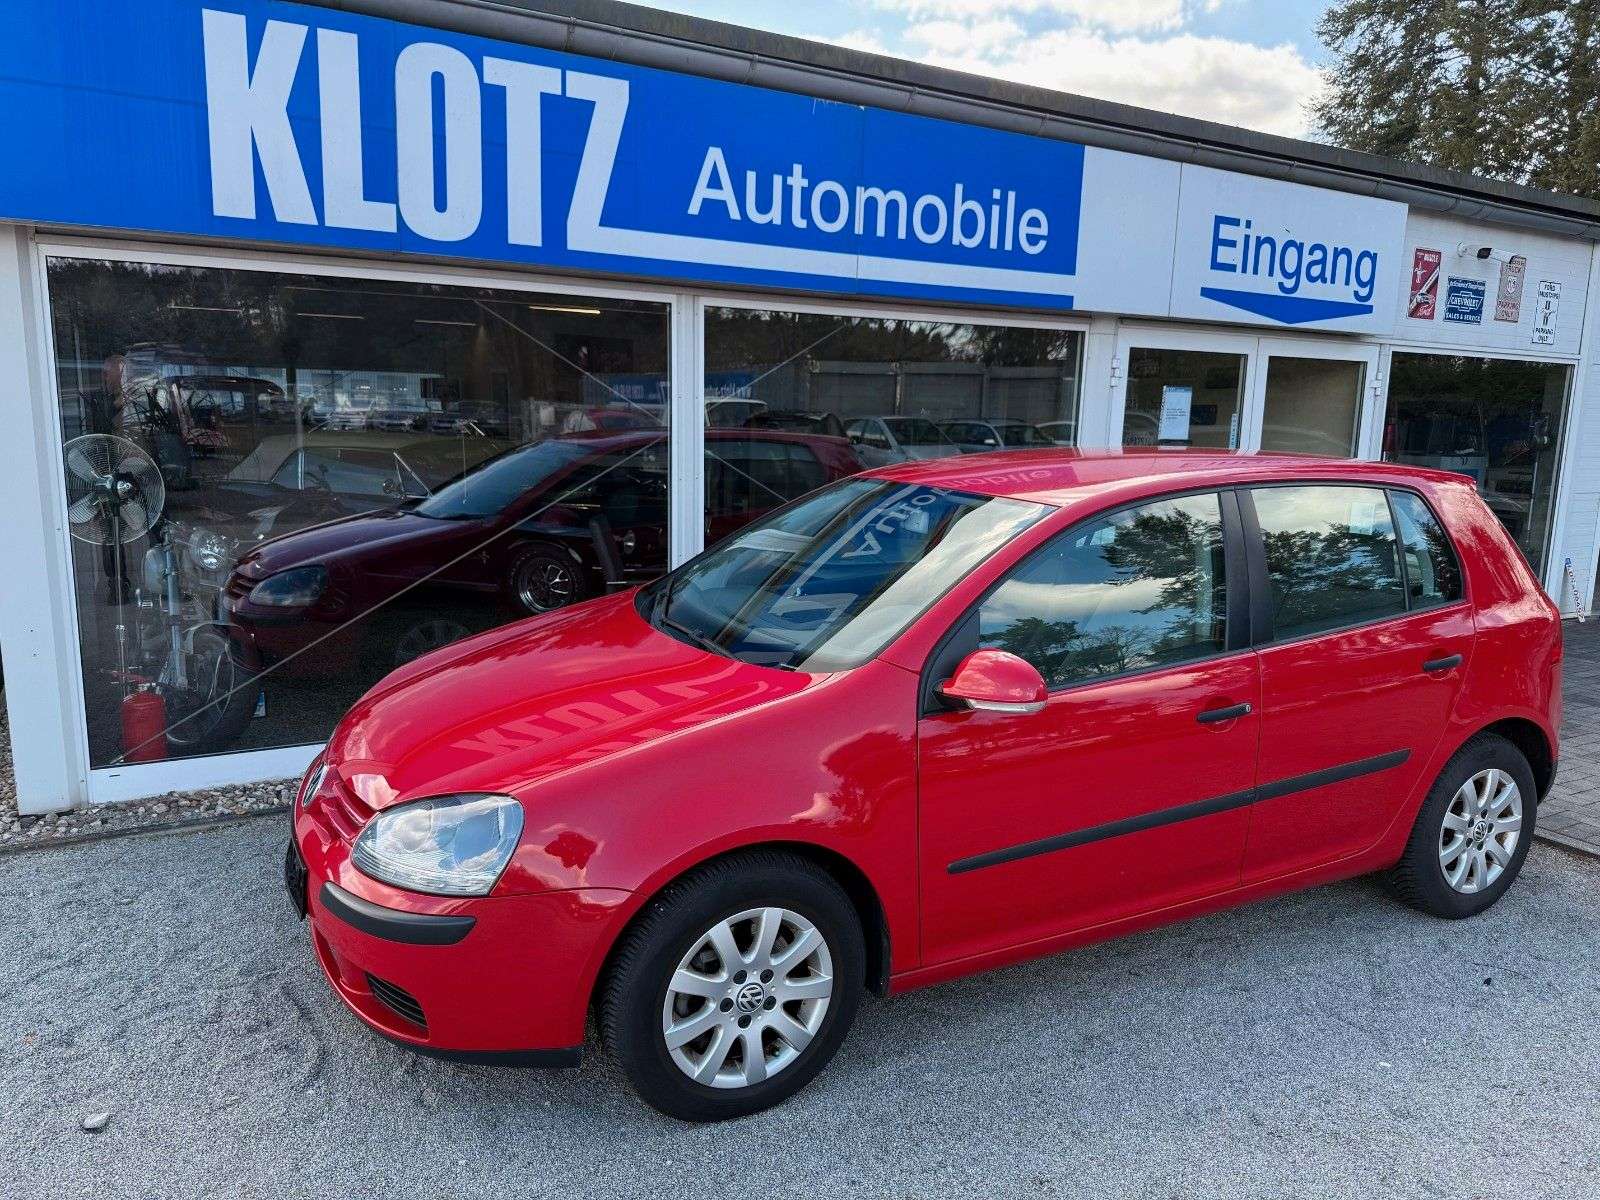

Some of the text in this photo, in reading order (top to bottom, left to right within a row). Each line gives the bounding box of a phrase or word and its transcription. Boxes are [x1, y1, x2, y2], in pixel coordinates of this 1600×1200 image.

[202, 8, 1050, 256] KLOTZ Automobile
[1209, 215, 1379, 303] Eingang
